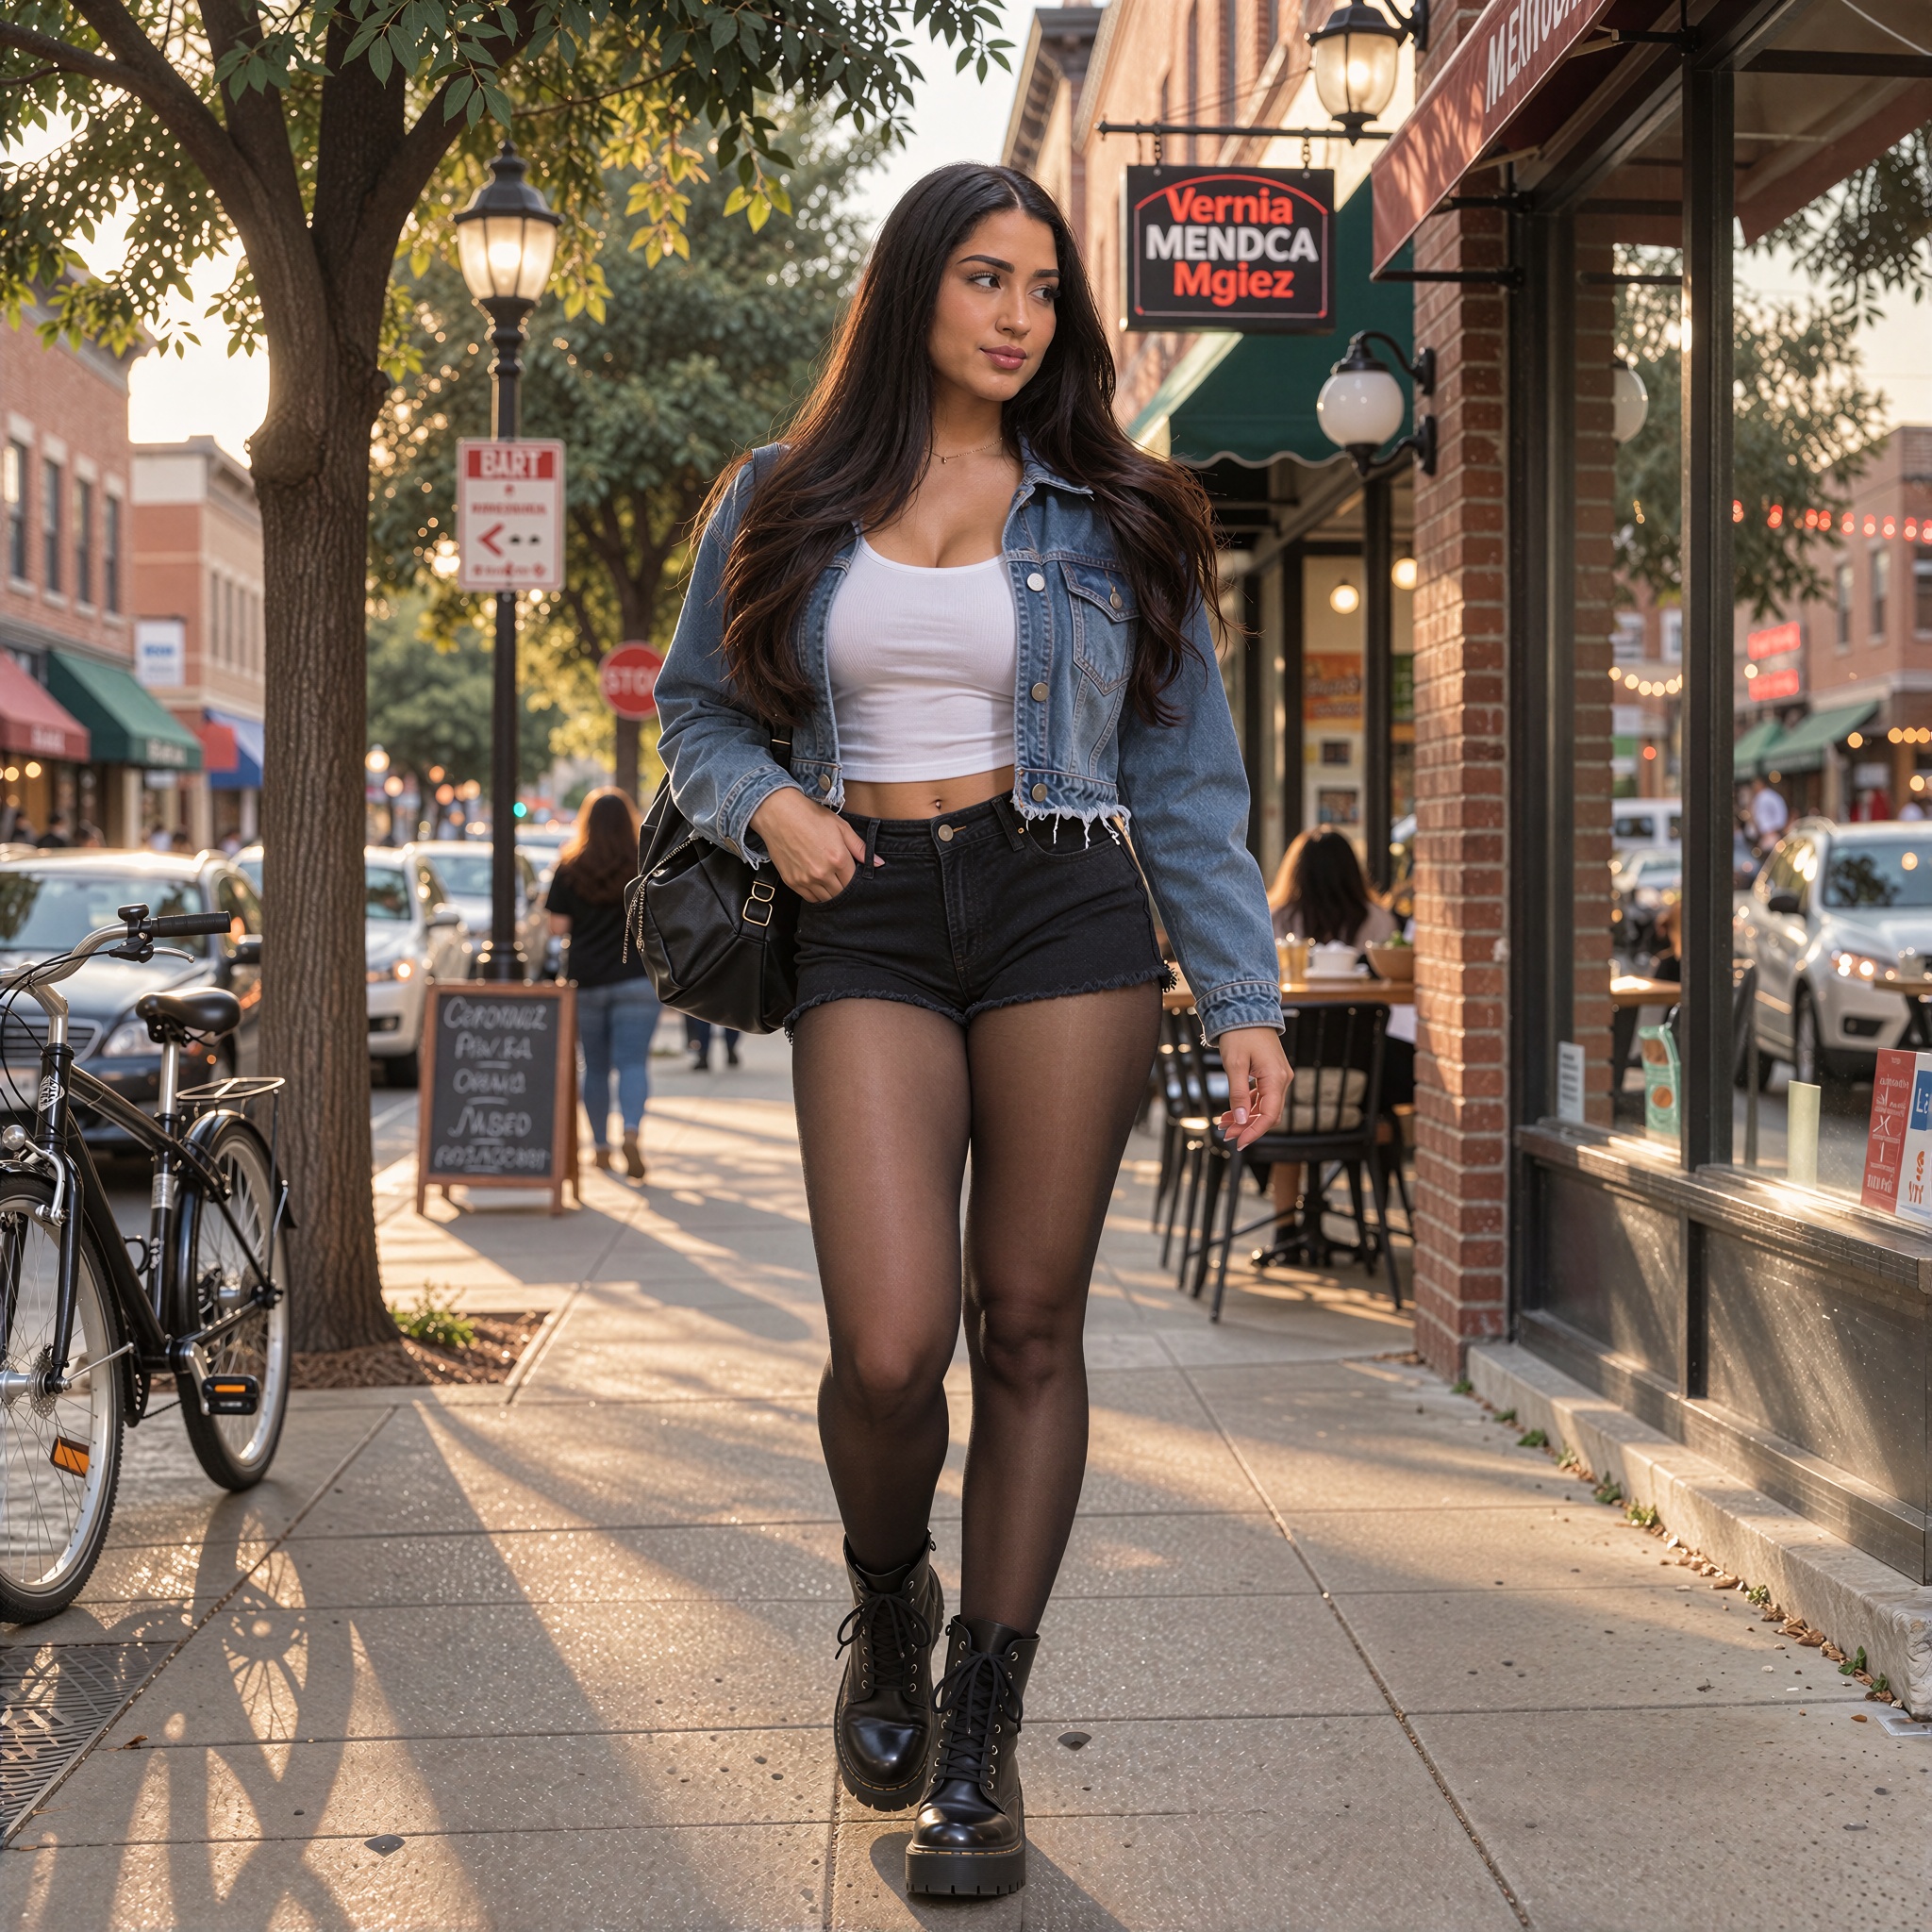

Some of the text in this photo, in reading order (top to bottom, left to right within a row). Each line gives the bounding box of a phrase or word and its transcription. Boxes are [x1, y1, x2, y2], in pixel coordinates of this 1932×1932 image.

[1165, 187, 1293, 225] Vernia
[1145, 224, 1320, 262] MENDCA
[1173, 260, 1295, 307] Mgiez
[479, 449, 541, 476] BART
